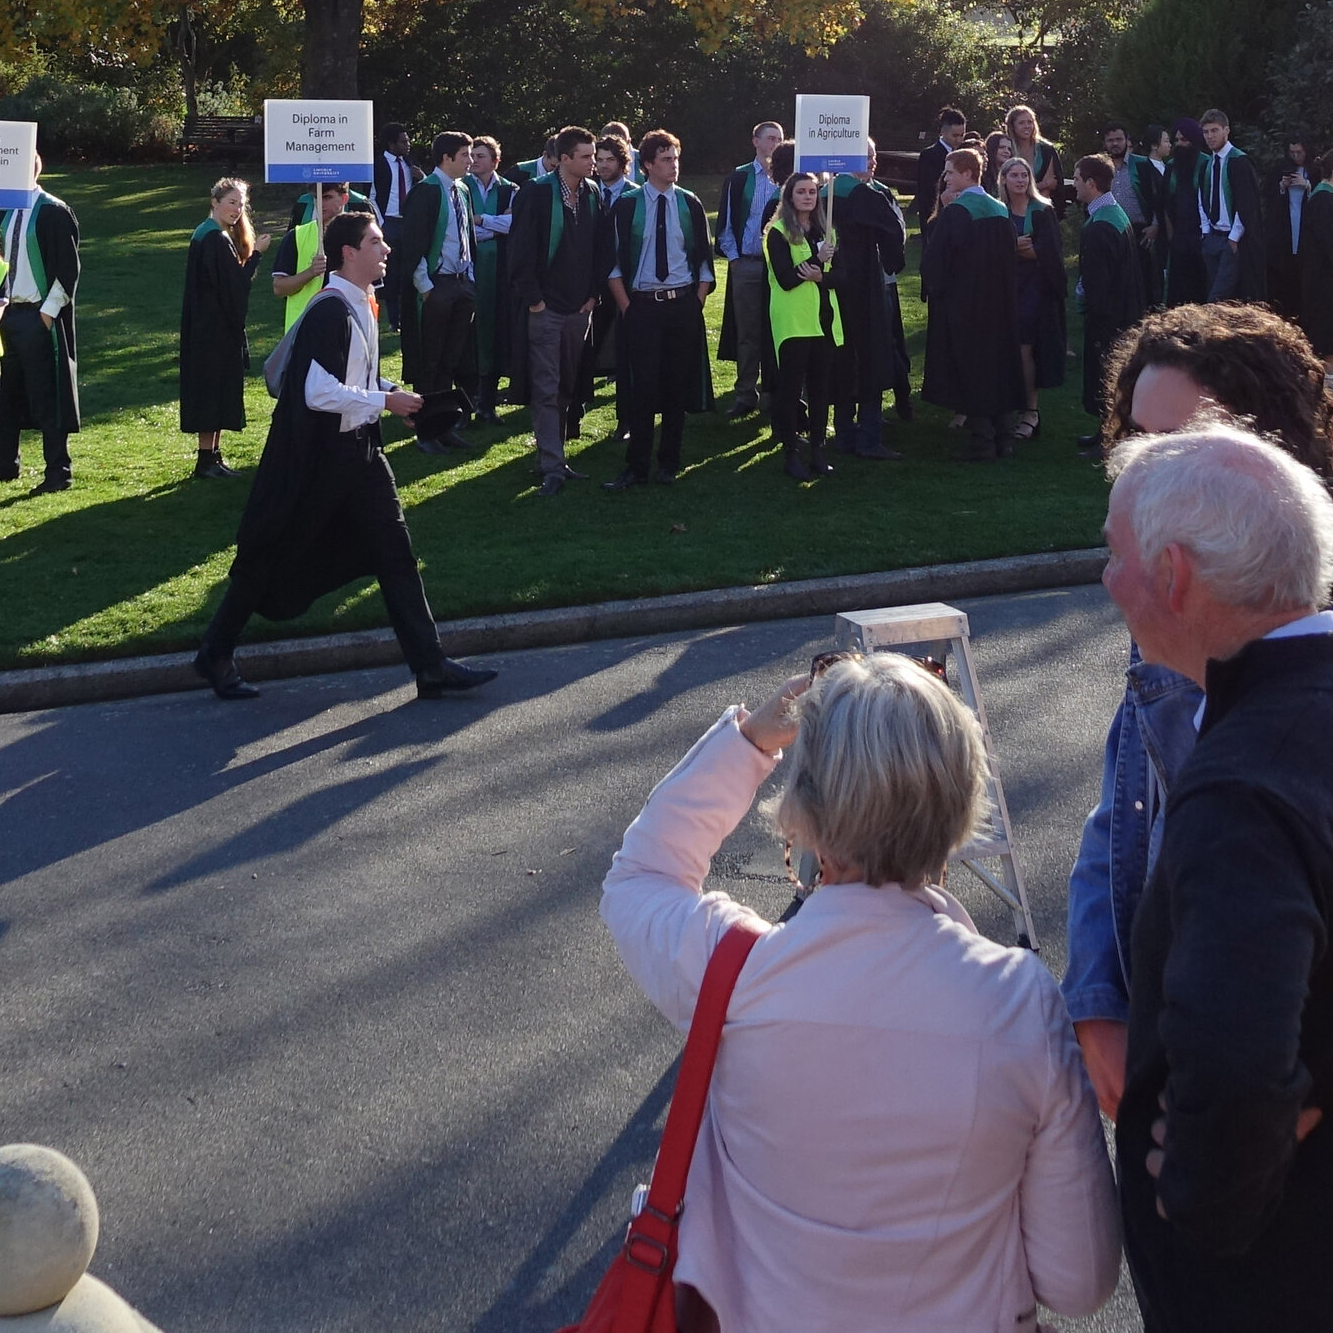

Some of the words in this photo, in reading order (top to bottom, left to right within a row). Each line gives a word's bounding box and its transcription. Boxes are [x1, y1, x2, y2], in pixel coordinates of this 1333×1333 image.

[292, 114, 336, 126] Diploma
[338, 114, 348, 124] in
[819, 114, 851, 126] Diploma
[308, 128, 335, 138] Farm
[808, 128, 816, 138] in
[817, 127, 860, 140] Agriculture
[285, 141, 355, 153] Management
[0, 157, 9, 166] in
